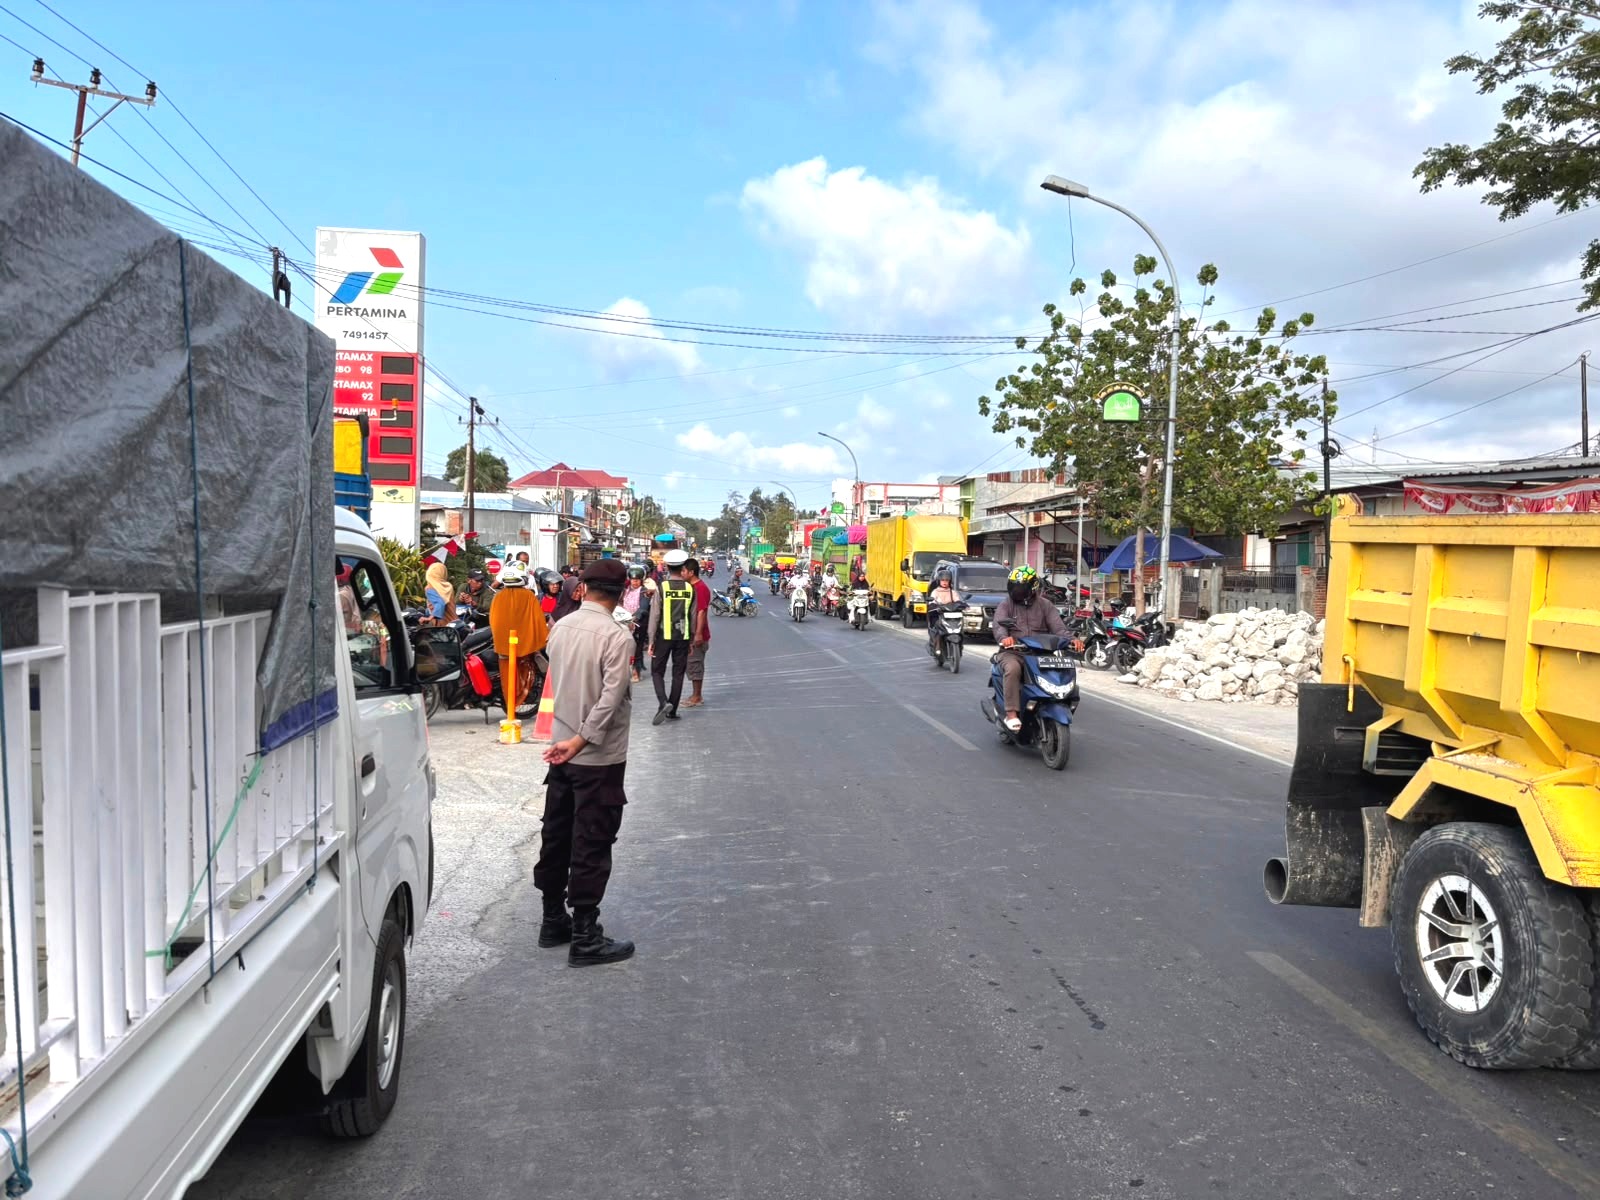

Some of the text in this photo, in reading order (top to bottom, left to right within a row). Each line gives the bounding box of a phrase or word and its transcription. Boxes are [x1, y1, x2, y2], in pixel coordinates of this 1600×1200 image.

[327, 306, 407, 319] PERTAMINA
[342, 330, 388, 340] 7491457
[335, 352, 373, 361] TAMAX
[360, 366, 373, 375] 98
[333, 380, 373, 389] RTAMAX
[361, 392, 373, 400] 92
